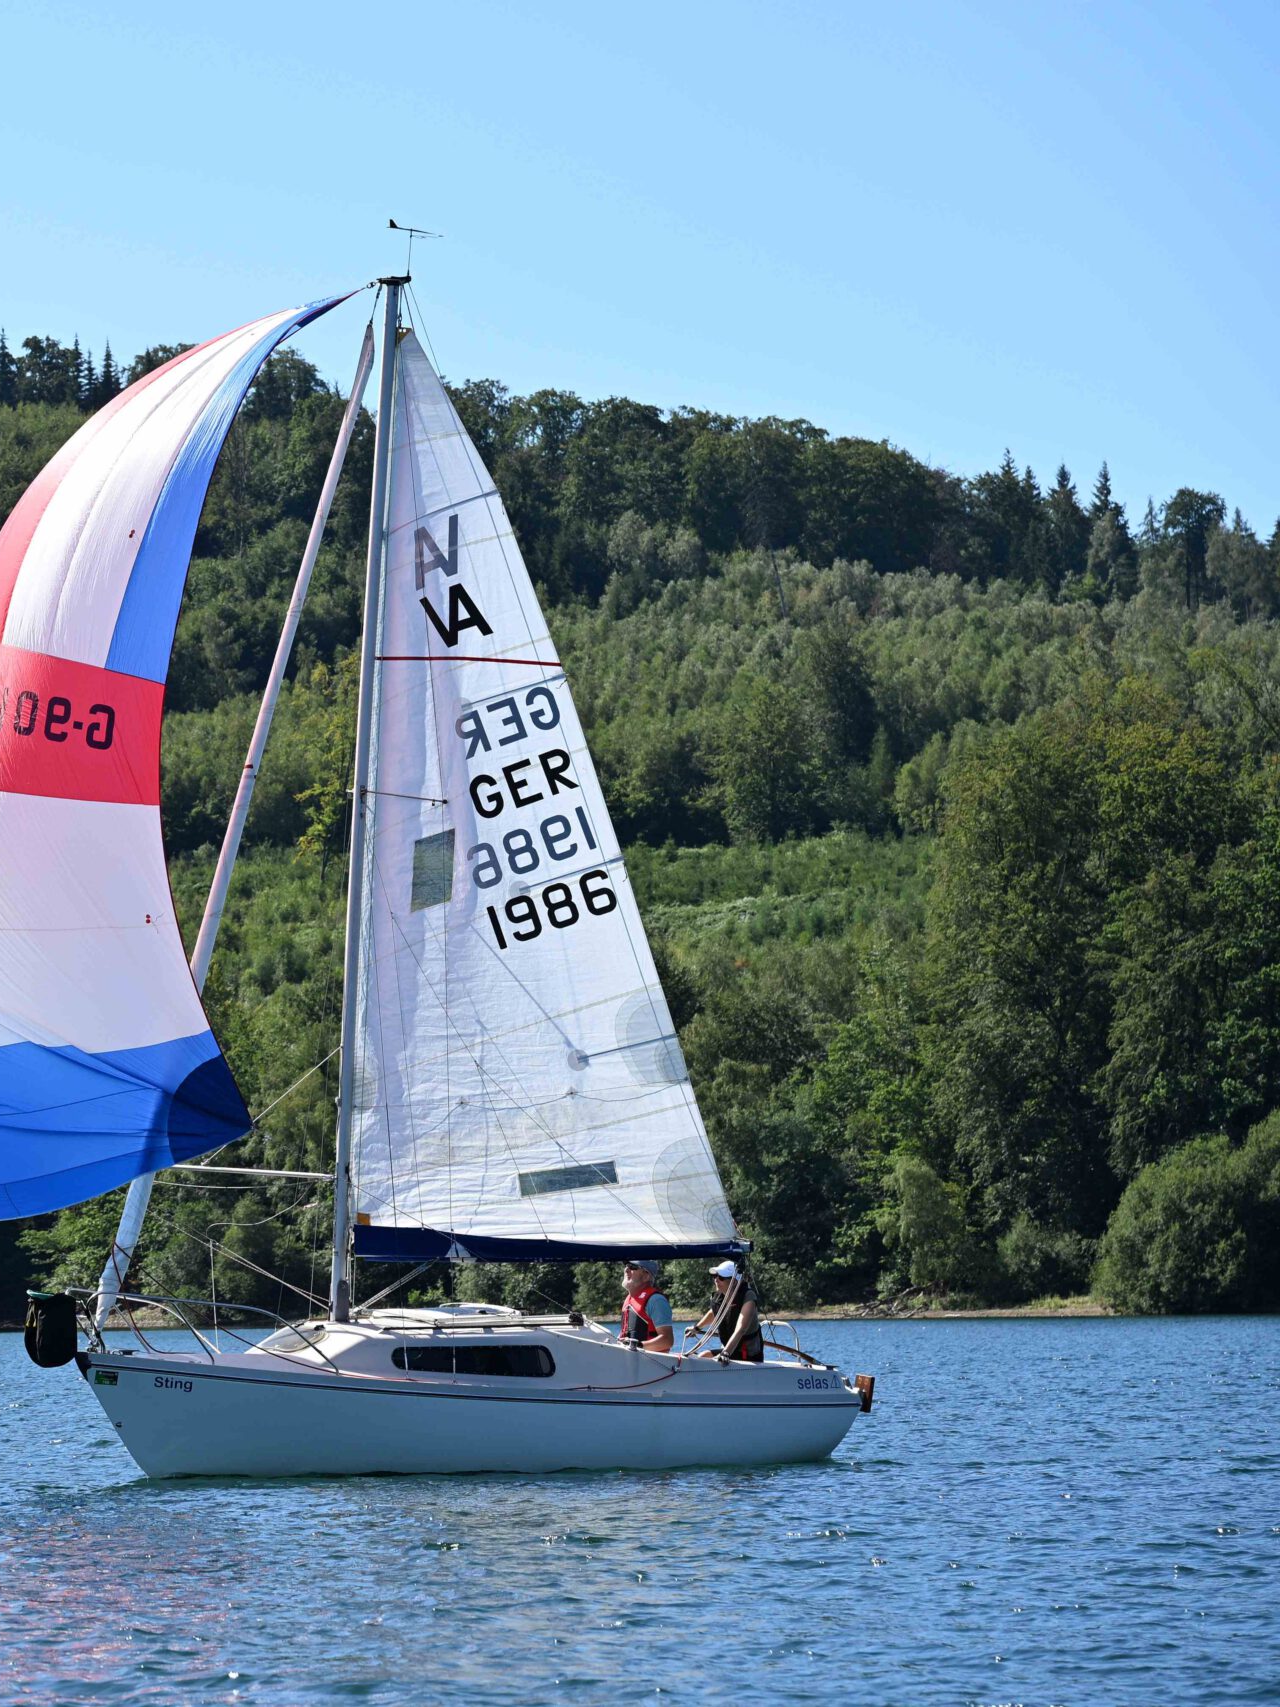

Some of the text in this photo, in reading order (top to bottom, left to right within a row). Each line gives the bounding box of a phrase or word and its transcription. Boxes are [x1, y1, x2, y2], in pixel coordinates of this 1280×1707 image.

[419, 582, 494, 648] VA
[469, 748, 580, 819] GER
[486, 869, 618, 951] 1986
[153, 1376, 193, 1393] Sting
[797, 1374, 829, 1390] selas
